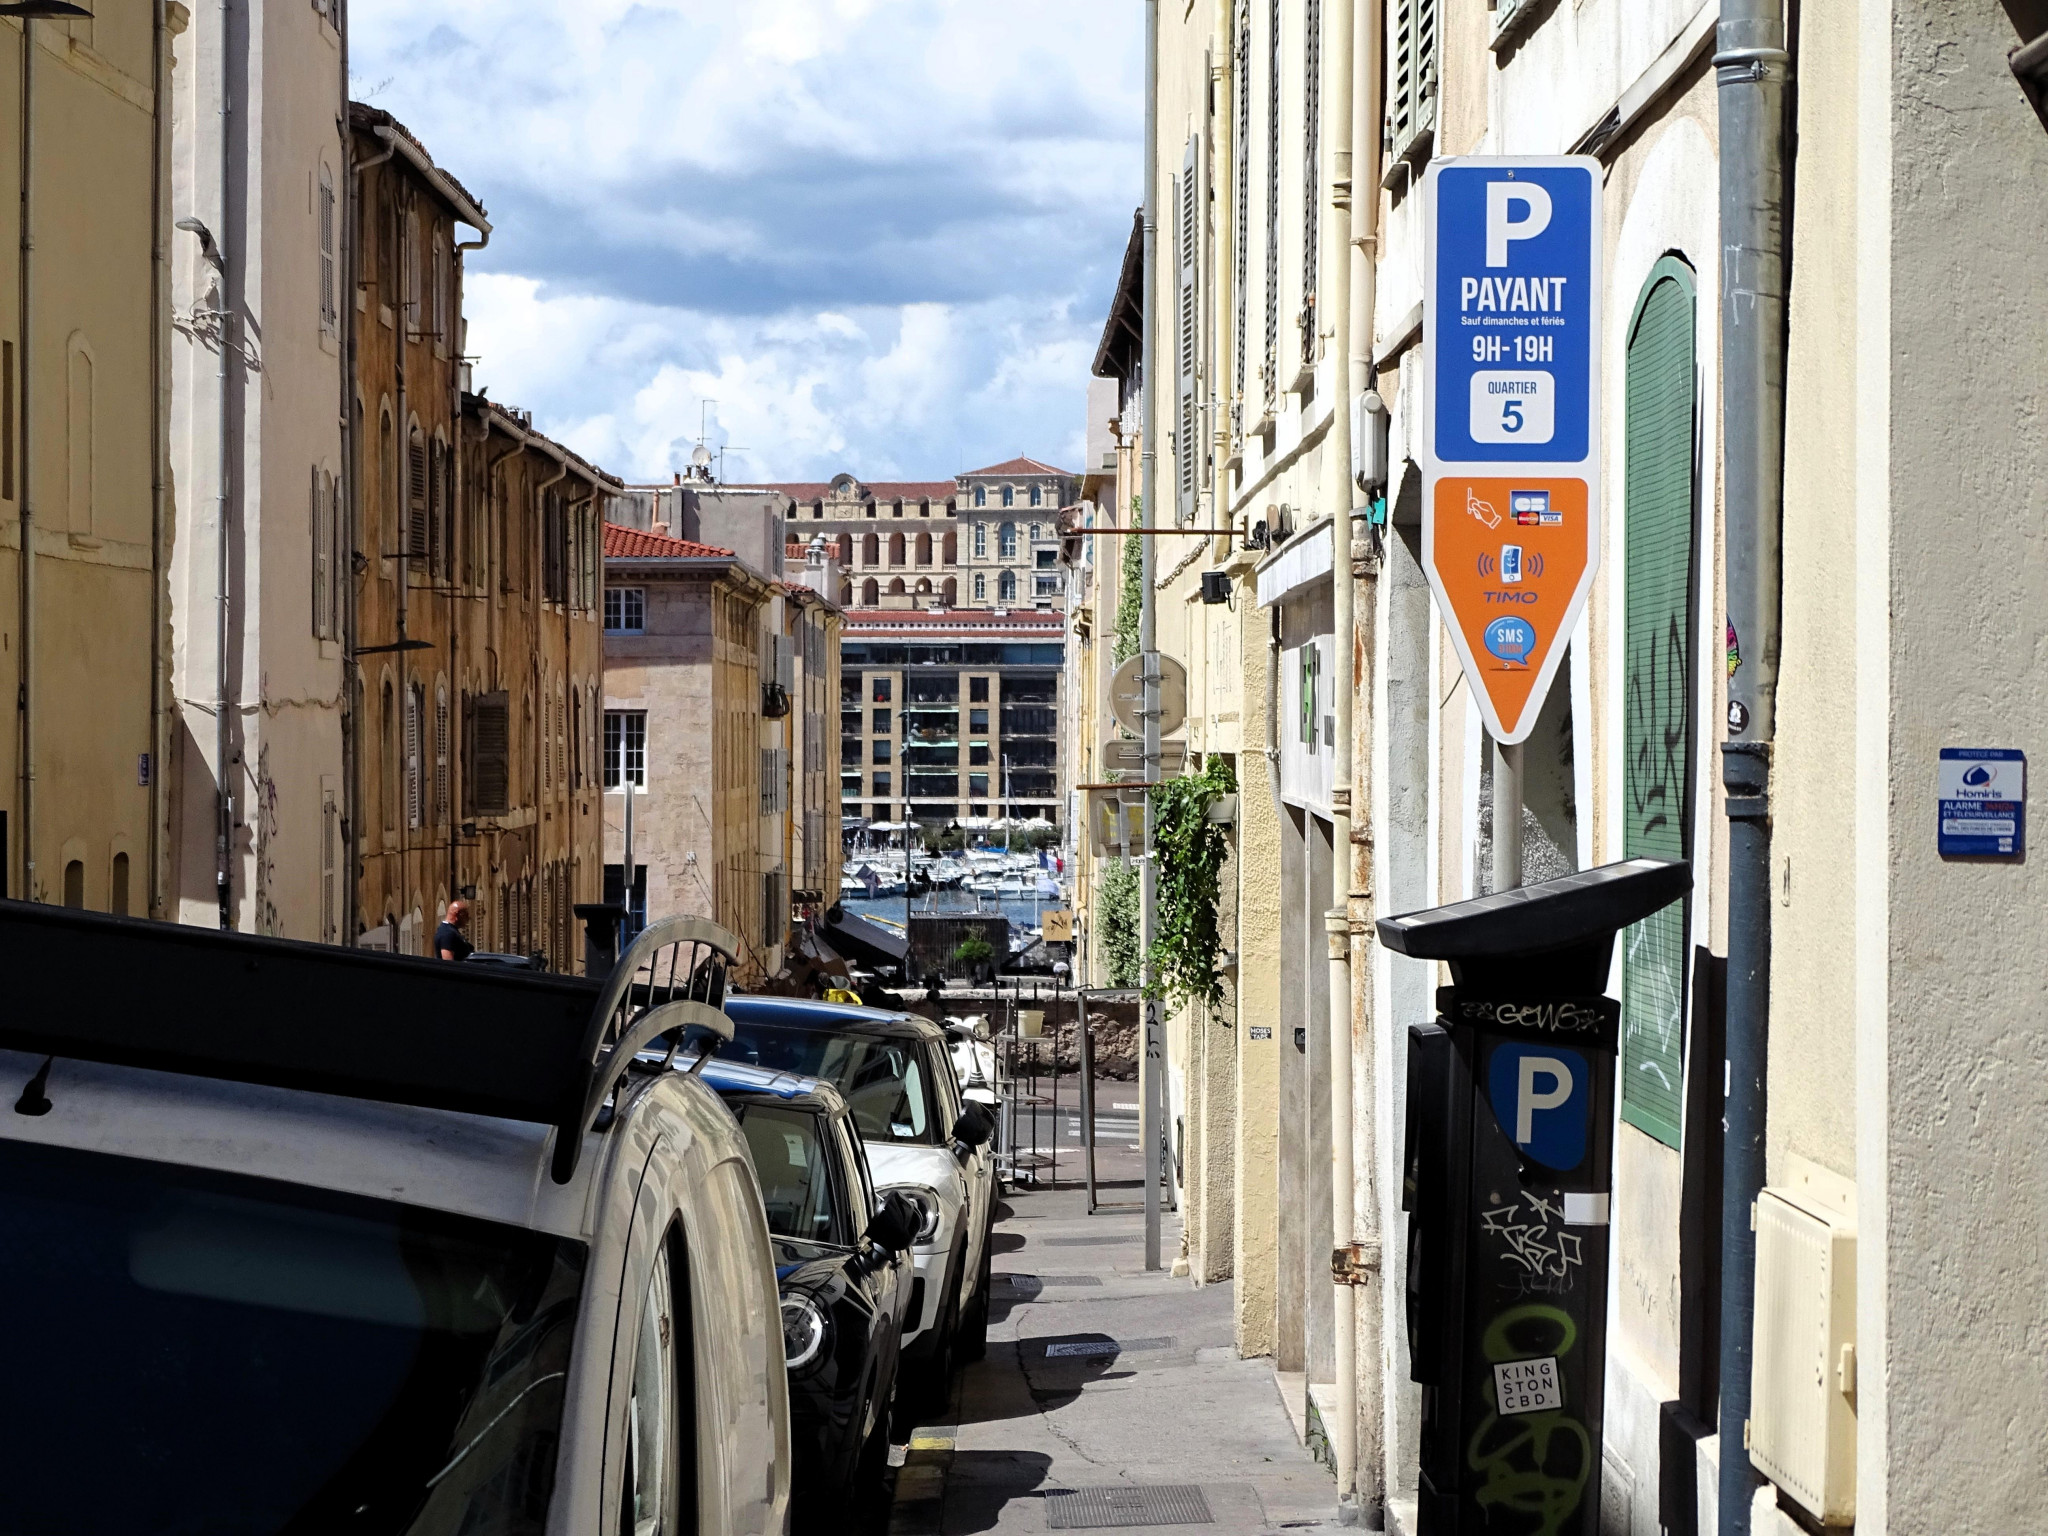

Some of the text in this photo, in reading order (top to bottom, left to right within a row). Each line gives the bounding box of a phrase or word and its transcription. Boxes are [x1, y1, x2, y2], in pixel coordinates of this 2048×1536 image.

[1485, 181, 1553, 268] P
[1461, 277, 1567, 311] PAYANT
[1461, 316, 1565, 326] Sauf dimanches et fériés
[1488, 381, 1537, 394] QUARTIER
[1501, 400, 1524, 433] 5
[1483, 591, 1538, 604] TIMO
[1497, 628, 1524, 643] SMS
[1956, 789, 2002, 799] Homiris
[1943, 801, 1982, 811] ALARME
[1515, 1056, 1574, 1144] P
[1501, 1363, 1551, 1380] KING
[1503, 1377, 1553, 1394] STON
[1505, 1393, 1553, 1409] CBD.
